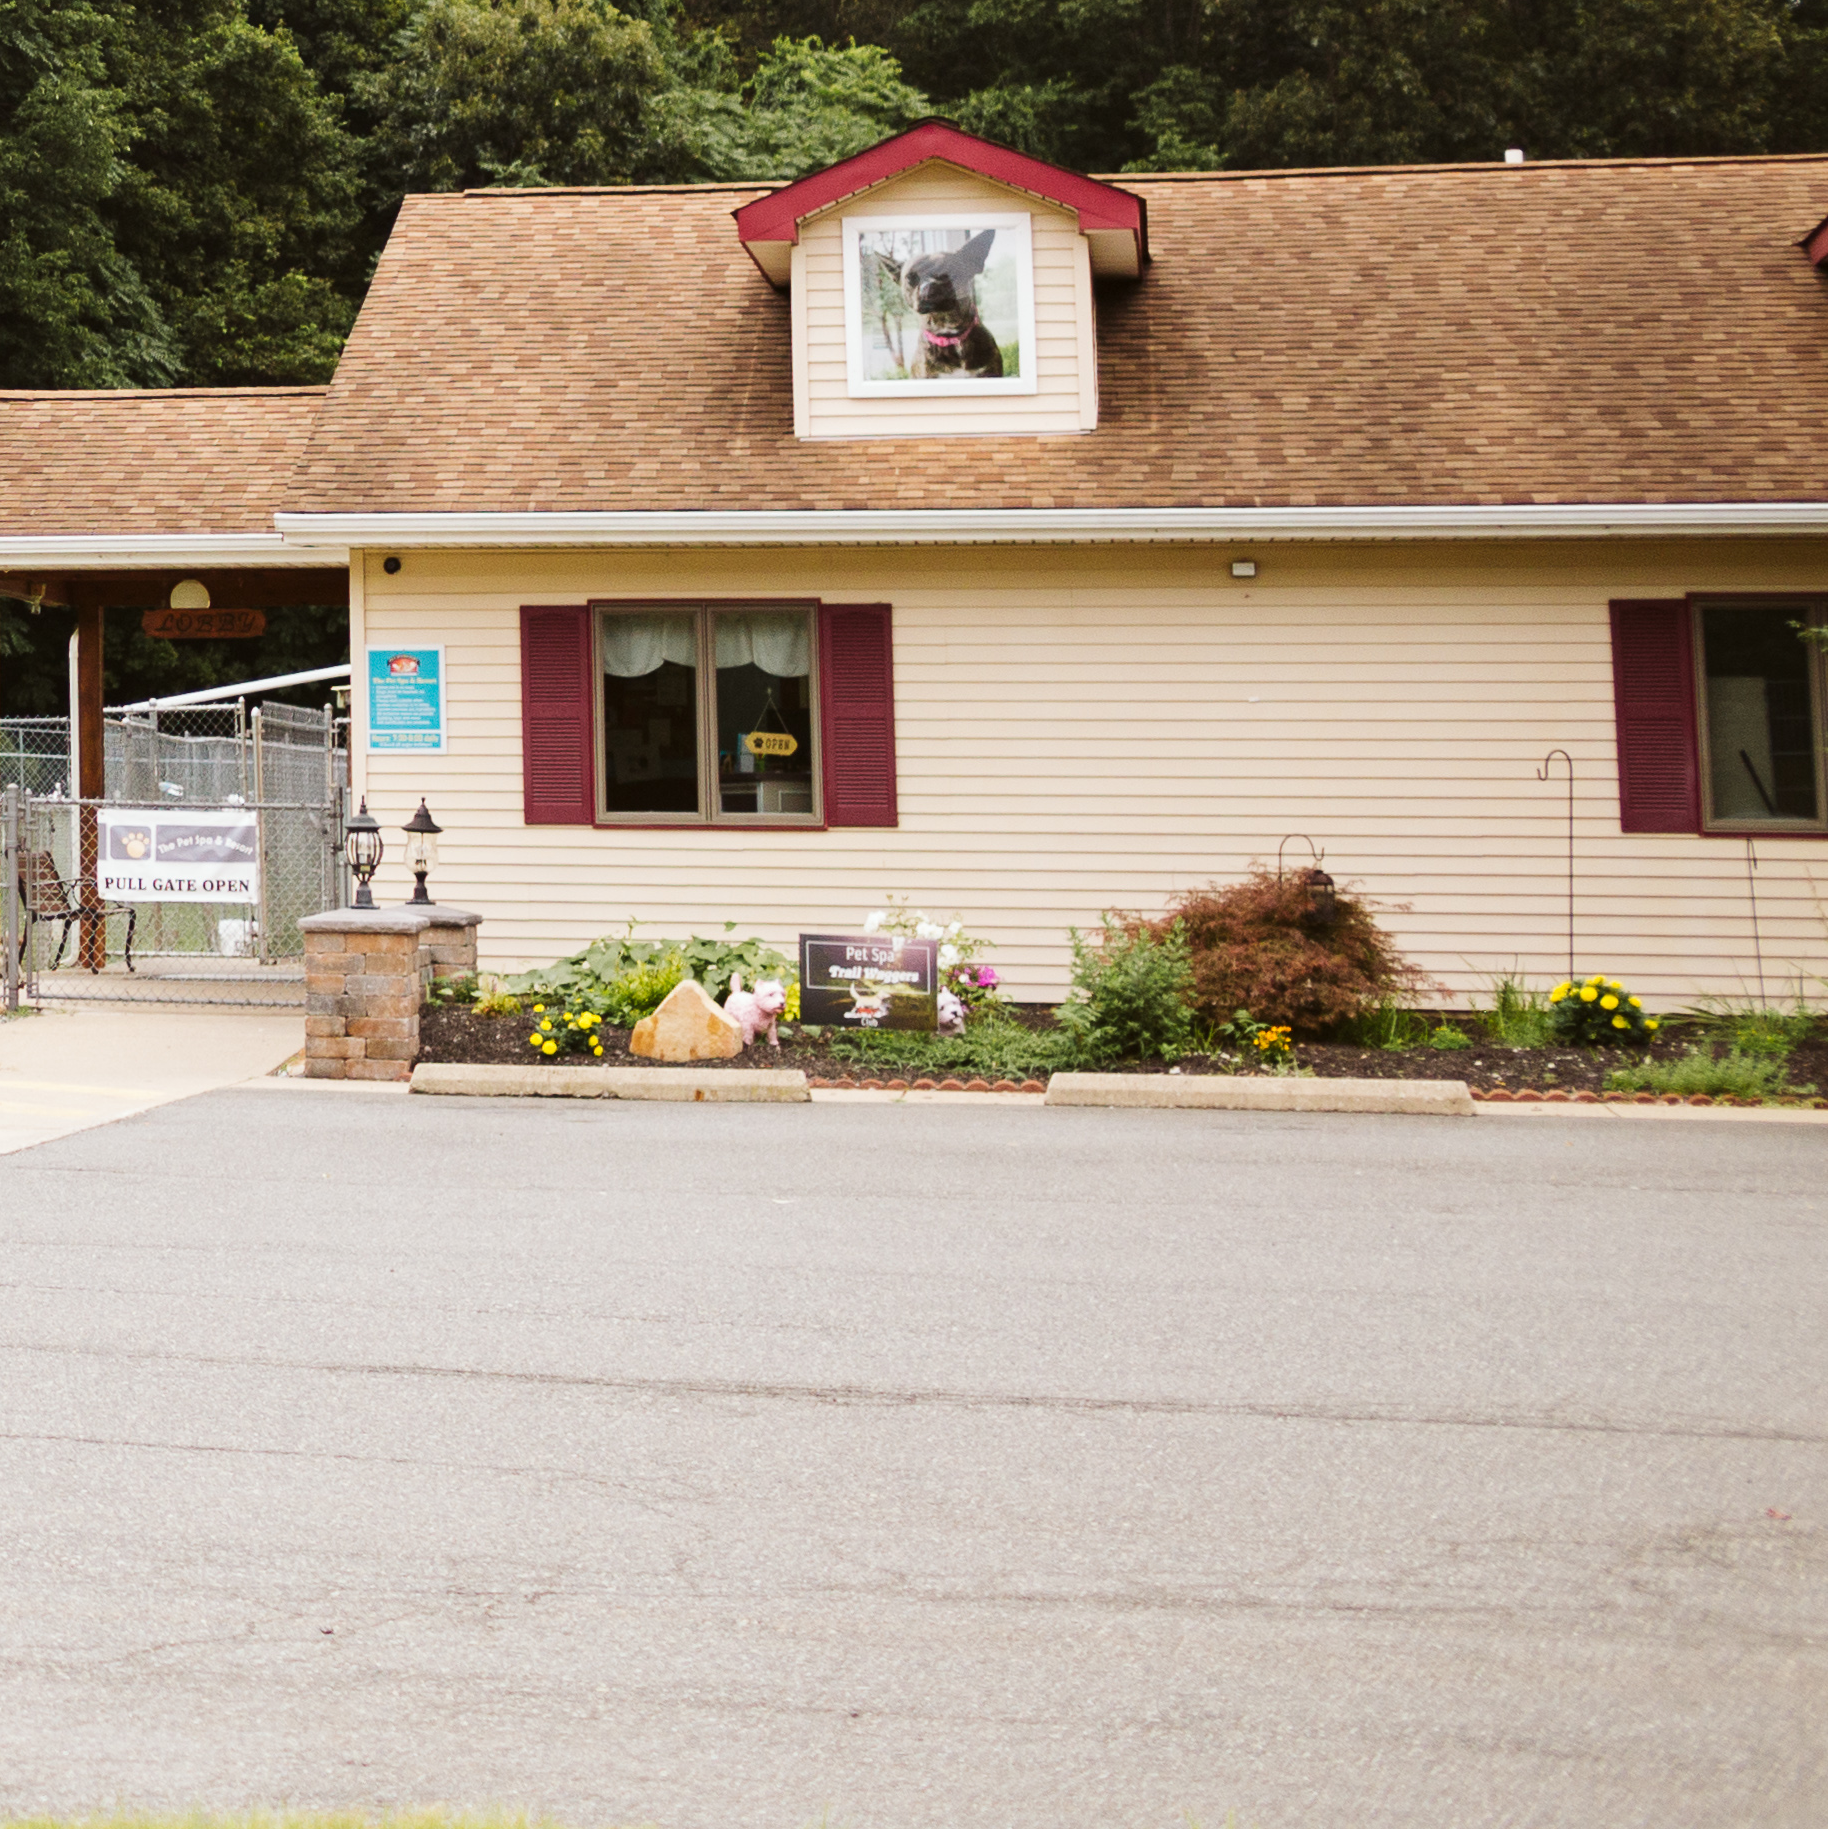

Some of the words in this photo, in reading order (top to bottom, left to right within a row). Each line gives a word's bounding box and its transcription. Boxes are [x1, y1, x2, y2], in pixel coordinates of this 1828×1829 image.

[155, 612, 256, 633] LOBBY
[766, 738, 790, 750] OPEN
[158, 842, 176, 854] The
[176, 836, 193, 848] Pet
[195, 834, 213, 847] Spa
[215, 835, 223, 846] &
[224, 837, 254, 856] Resort
[104, 877, 147, 891] PULL
[152, 878, 197, 892] GATE
[202, 879, 250, 893] OPEN
[846, 946, 868, 962] Pet
[871, 947, 895, 965] Spa
[828, 964, 862, 979] Trail
